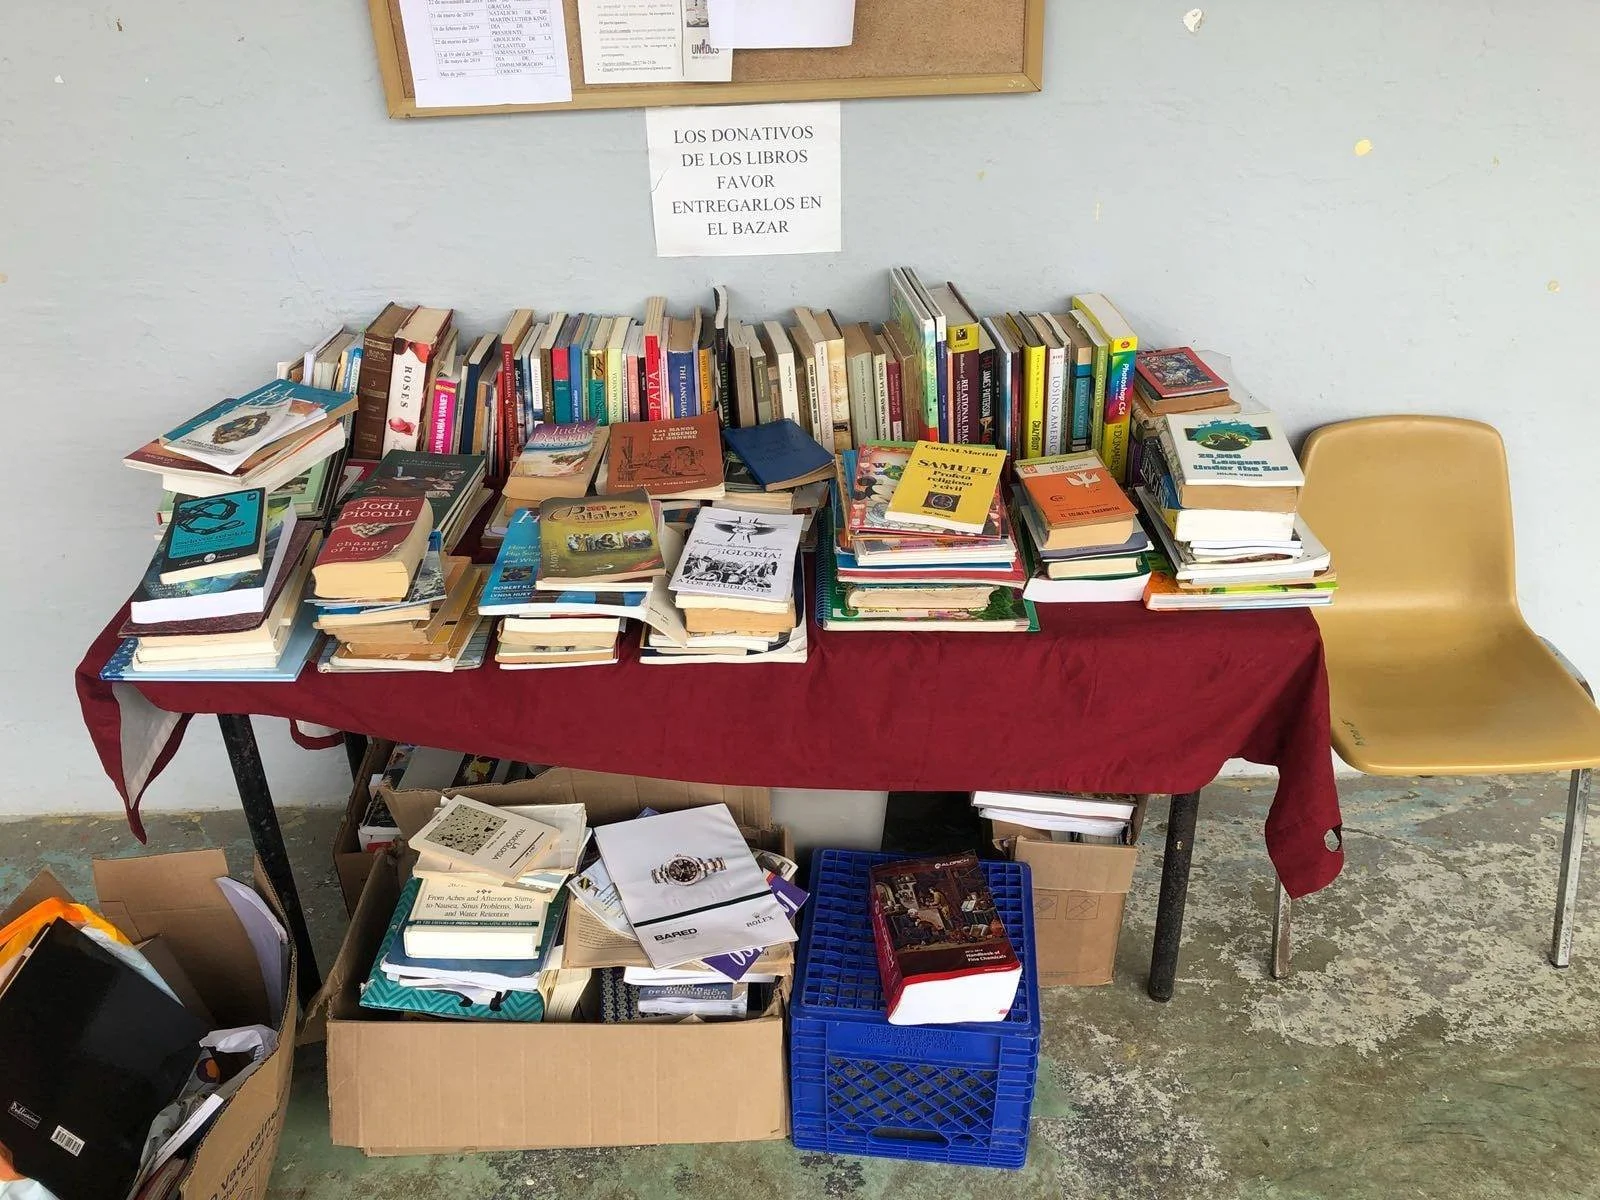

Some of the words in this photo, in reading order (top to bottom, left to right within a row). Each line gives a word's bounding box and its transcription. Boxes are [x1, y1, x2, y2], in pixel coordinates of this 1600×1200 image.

[674, 130, 706, 144] LOS
[712, 126, 813, 142] DONATIVOS
[682, 153, 705, 167] DE
[710, 152, 742, 166] LOS
[747, 150, 808, 165] LIBROS
[717, 175, 775, 189] FAVOR
[672, 196, 794, 214] ENTREGARLOS
[800, 196, 822, 209] EN
[708, 222, 727, 236] EL
[732, 220, 788, 235] BAZAR
[400, 366, 412, 409] ROSES
[984, 370, 992, 388] JAMES
[1119, 363, 1129, 400] Photoshop
[650, 372, 660, 411] PAPA
[680, 382, 688, 418] LANGUAG
[1052, 375, 1061, 411] LOSING
[962, 379, 970, 423] RELATIONAL
[982, 389, 991, 418] PATTERSON
[1118, 402, 1126, 415] CS4
[552, 424, 582, 435] Jude
[1050, 414, 1060, 456] AMERICA
[918, 460, 992, 476] SAMUEL
[933, 470, 971, 480] Profeta
[927, 476, 973, 486] religioso
[357, 502, 400, 510] Jodi
[706, 582, 772, 593] ESTUDIANTES
[941, 858, 970, 867] ALDRICH
[746, 915, 774, 928] ROLEX
[654, 928, 698, 941] BARED
[221, 1103, 280, 1190] Vacutaine
